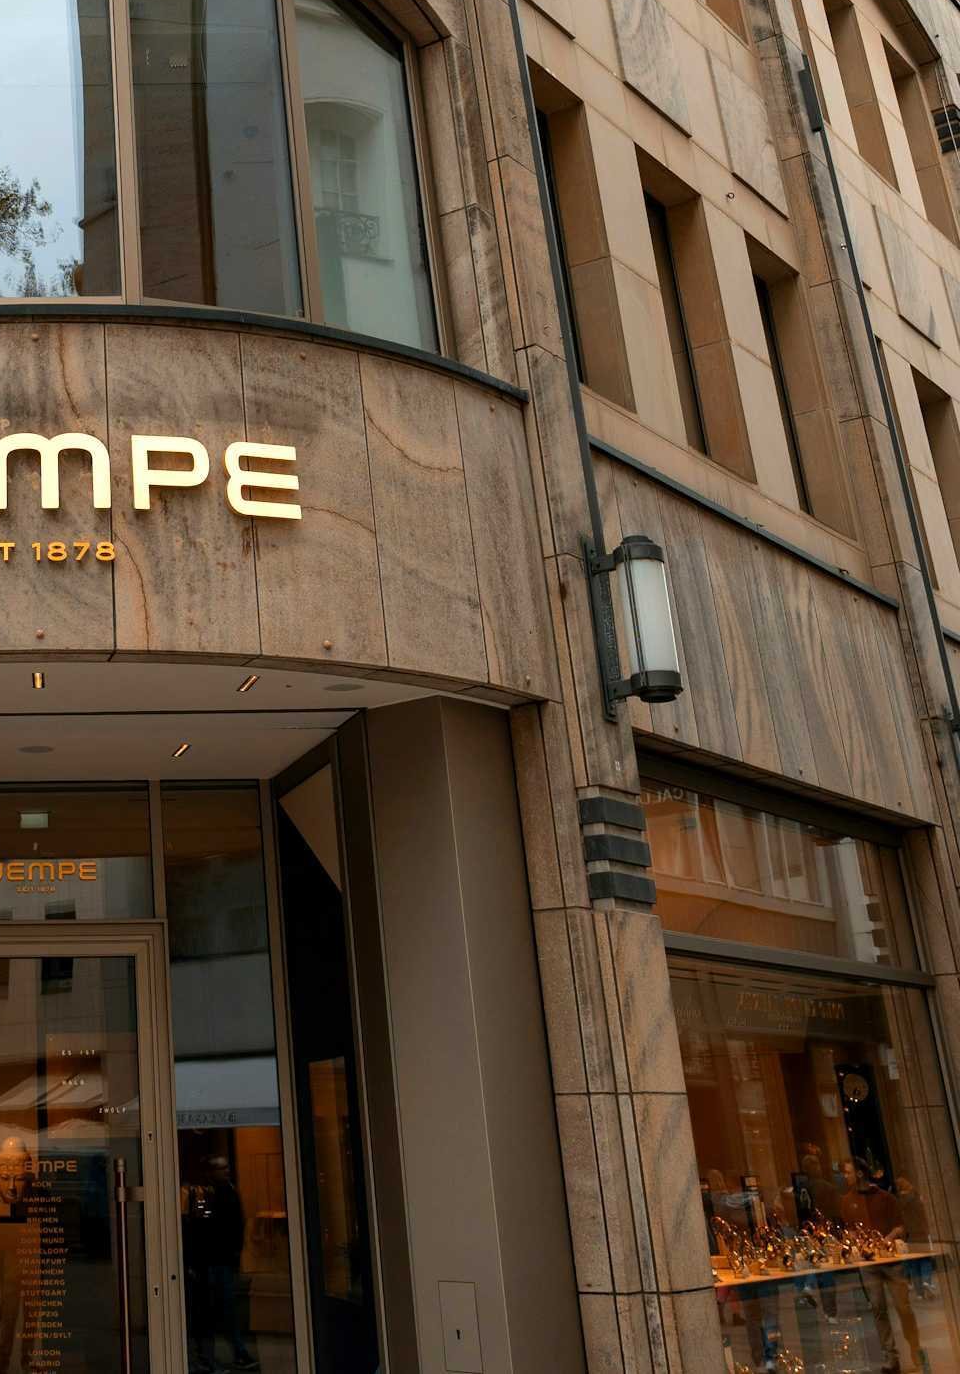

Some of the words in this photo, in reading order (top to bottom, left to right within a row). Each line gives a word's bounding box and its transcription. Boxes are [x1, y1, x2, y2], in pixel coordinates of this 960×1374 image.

[31, 541, 116, 562] 1878
[20, 1289, 67, 1297] STUTTGART
[28, 1310, 59, 1318] LEIPZIG
